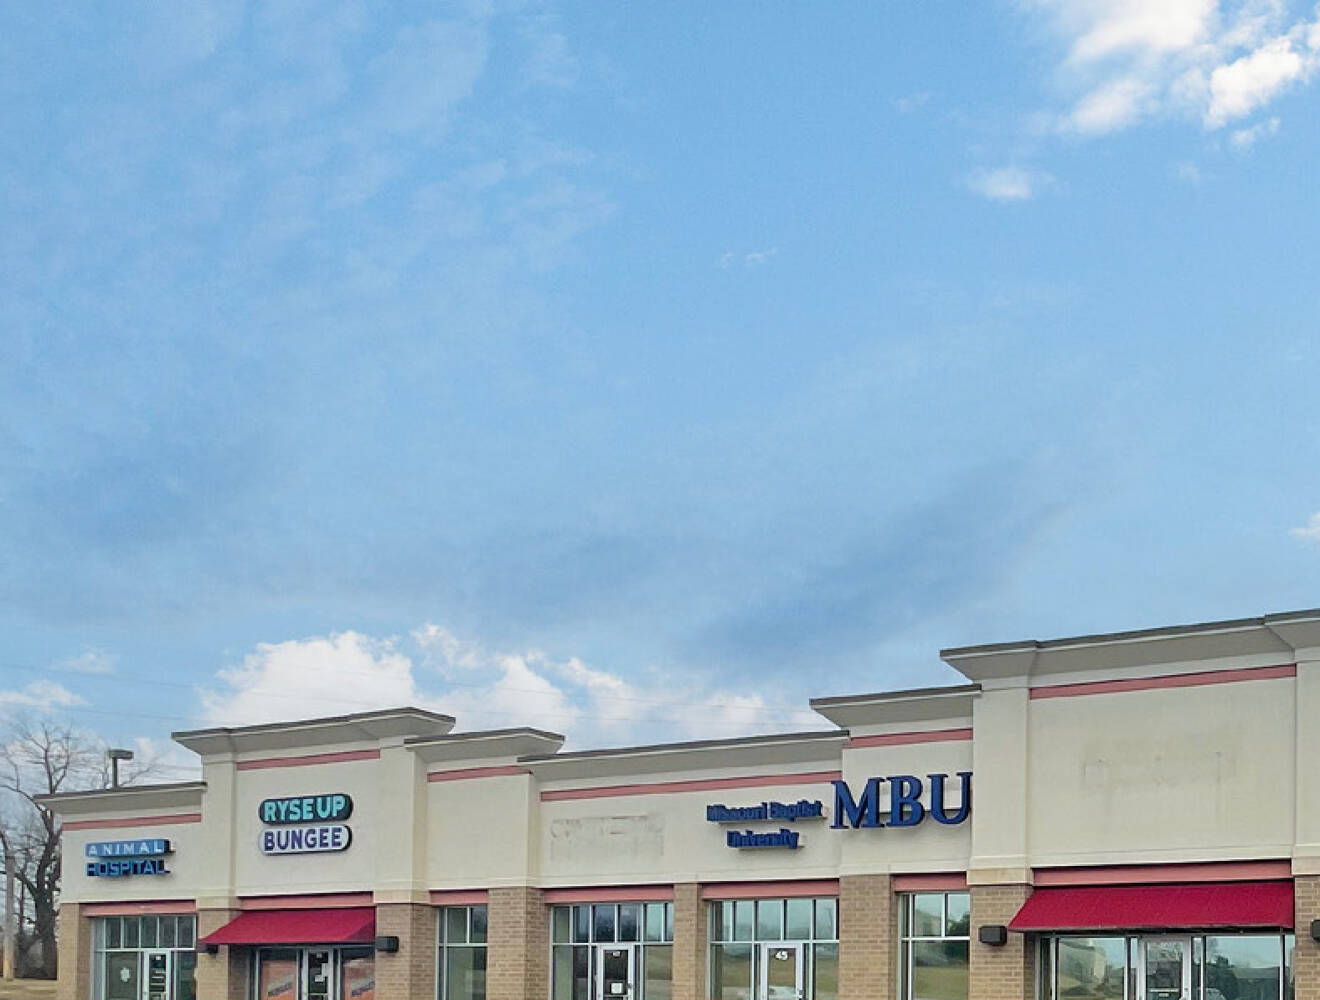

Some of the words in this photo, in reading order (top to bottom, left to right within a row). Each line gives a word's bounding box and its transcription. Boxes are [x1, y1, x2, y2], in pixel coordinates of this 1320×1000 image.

[830, 771, 973, 830] MBU
[88, 840, 165, 856] ANIMAL
[263, 827, 343, 852] BUNGEE
[726, 828, 799, 849] University
[87, 859, 166, 877] HOSPITAL
